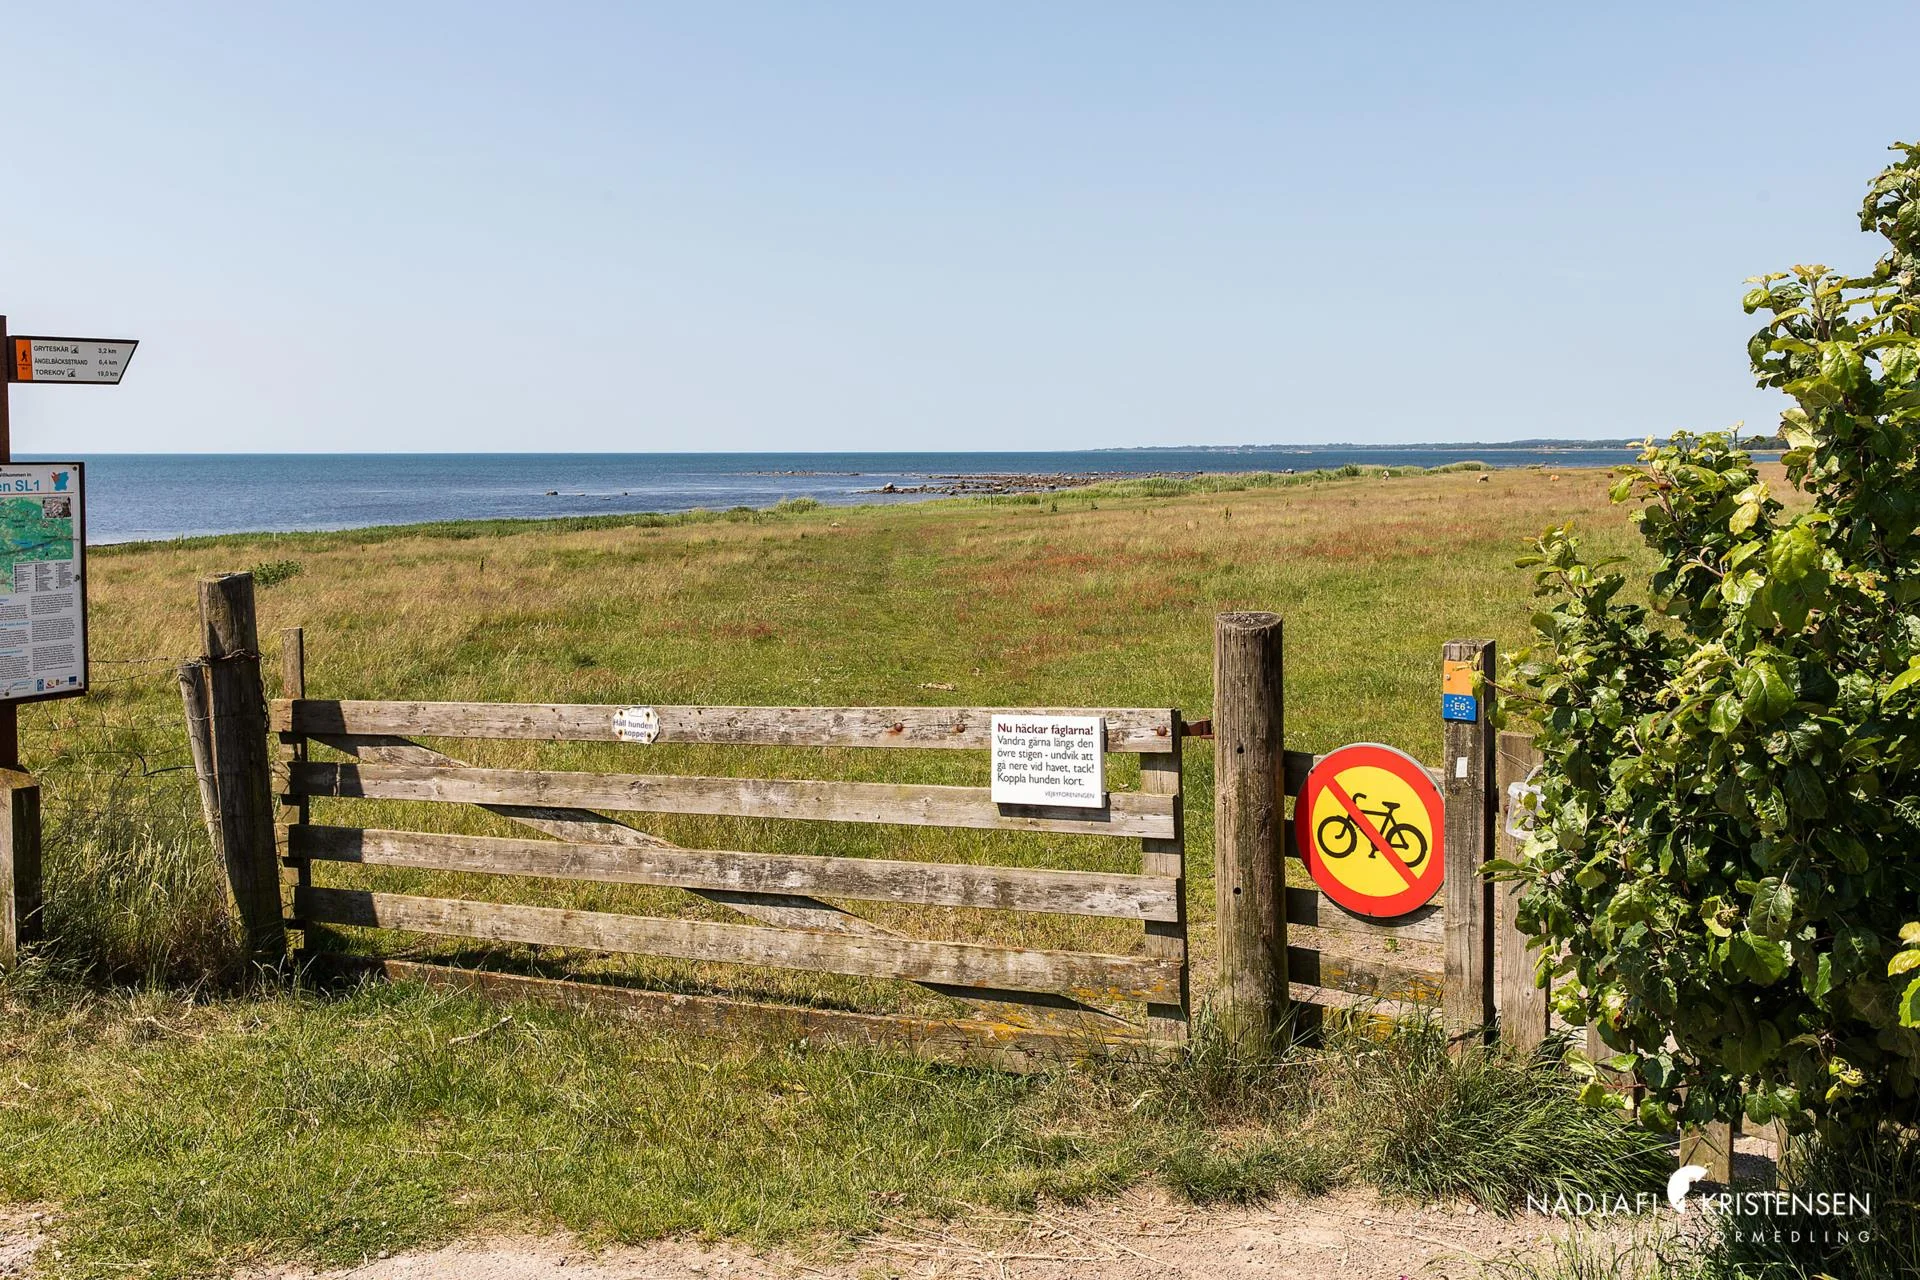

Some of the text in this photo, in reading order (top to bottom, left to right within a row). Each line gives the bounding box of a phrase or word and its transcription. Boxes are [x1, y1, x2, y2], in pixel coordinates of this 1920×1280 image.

[15, 479, 40, 492] SL1
[1454, 702, 1466, 711] E6
[997, 723, 1094, 737] Nu häckar fåglarna!
[997, 735, 1094, 750] Vandra gärna längs den
[997, 749, 1016, 758] övre
[1018, 750, 1043, 761] stigen
[1050, 751, 1079, 760] undvik
[1081, 753, 1094, 761] att
[996, 761, 1095, 774] gå nere vid havet, tack!
[997, 772, 1085, 786] Koppla hunden kort.
